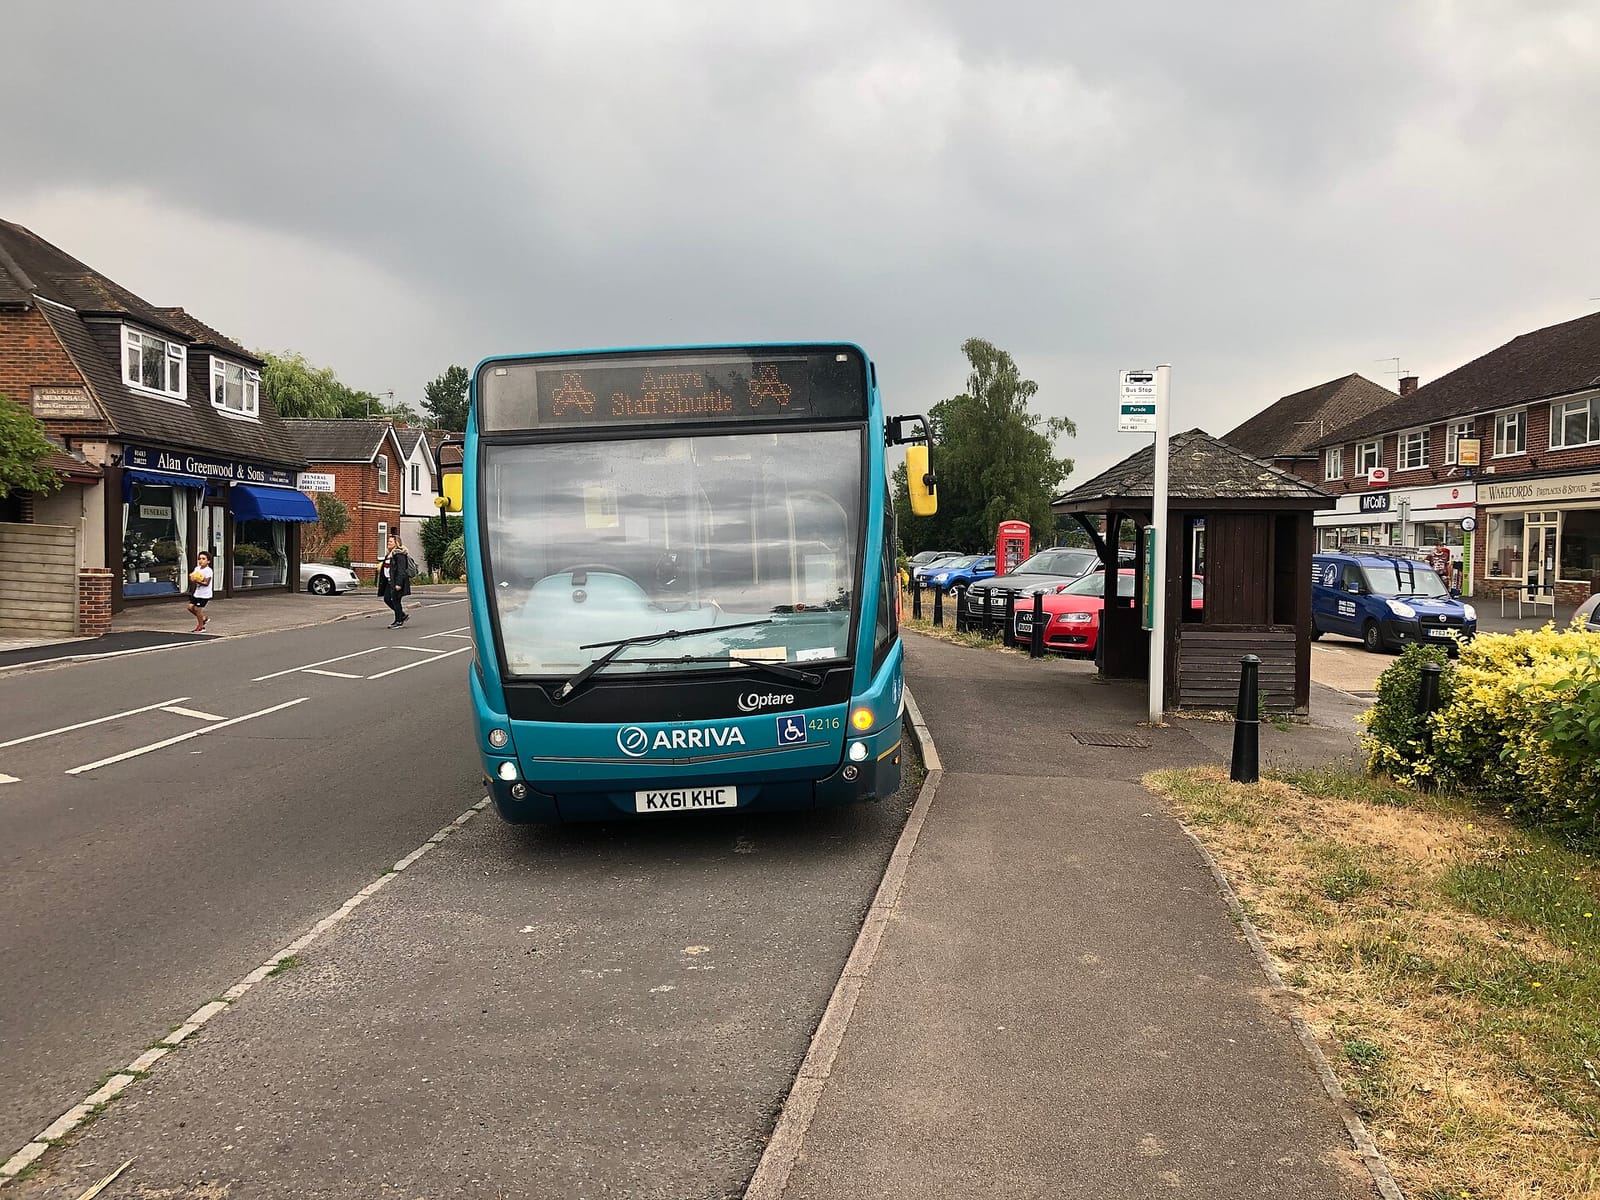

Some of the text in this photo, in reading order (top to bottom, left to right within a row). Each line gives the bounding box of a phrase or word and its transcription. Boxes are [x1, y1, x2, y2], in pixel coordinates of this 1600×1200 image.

[612, 388, 733, 416] Staff Shuttle
[157, 452, 265, 482] Alan Greenwood & Sons
[1488, 484, 1533, 501] WAKEFORDS
[1363, 495, 1386, 510] McColl's
[143, 508, 169, 517] FUNERALS
[745, 692, 795, 710] Optare
[808, 717, 840, 731] 4216
[652, 726, 746, 750] ARRIVA
[646, 789, 726, 809] KX61 KHC
